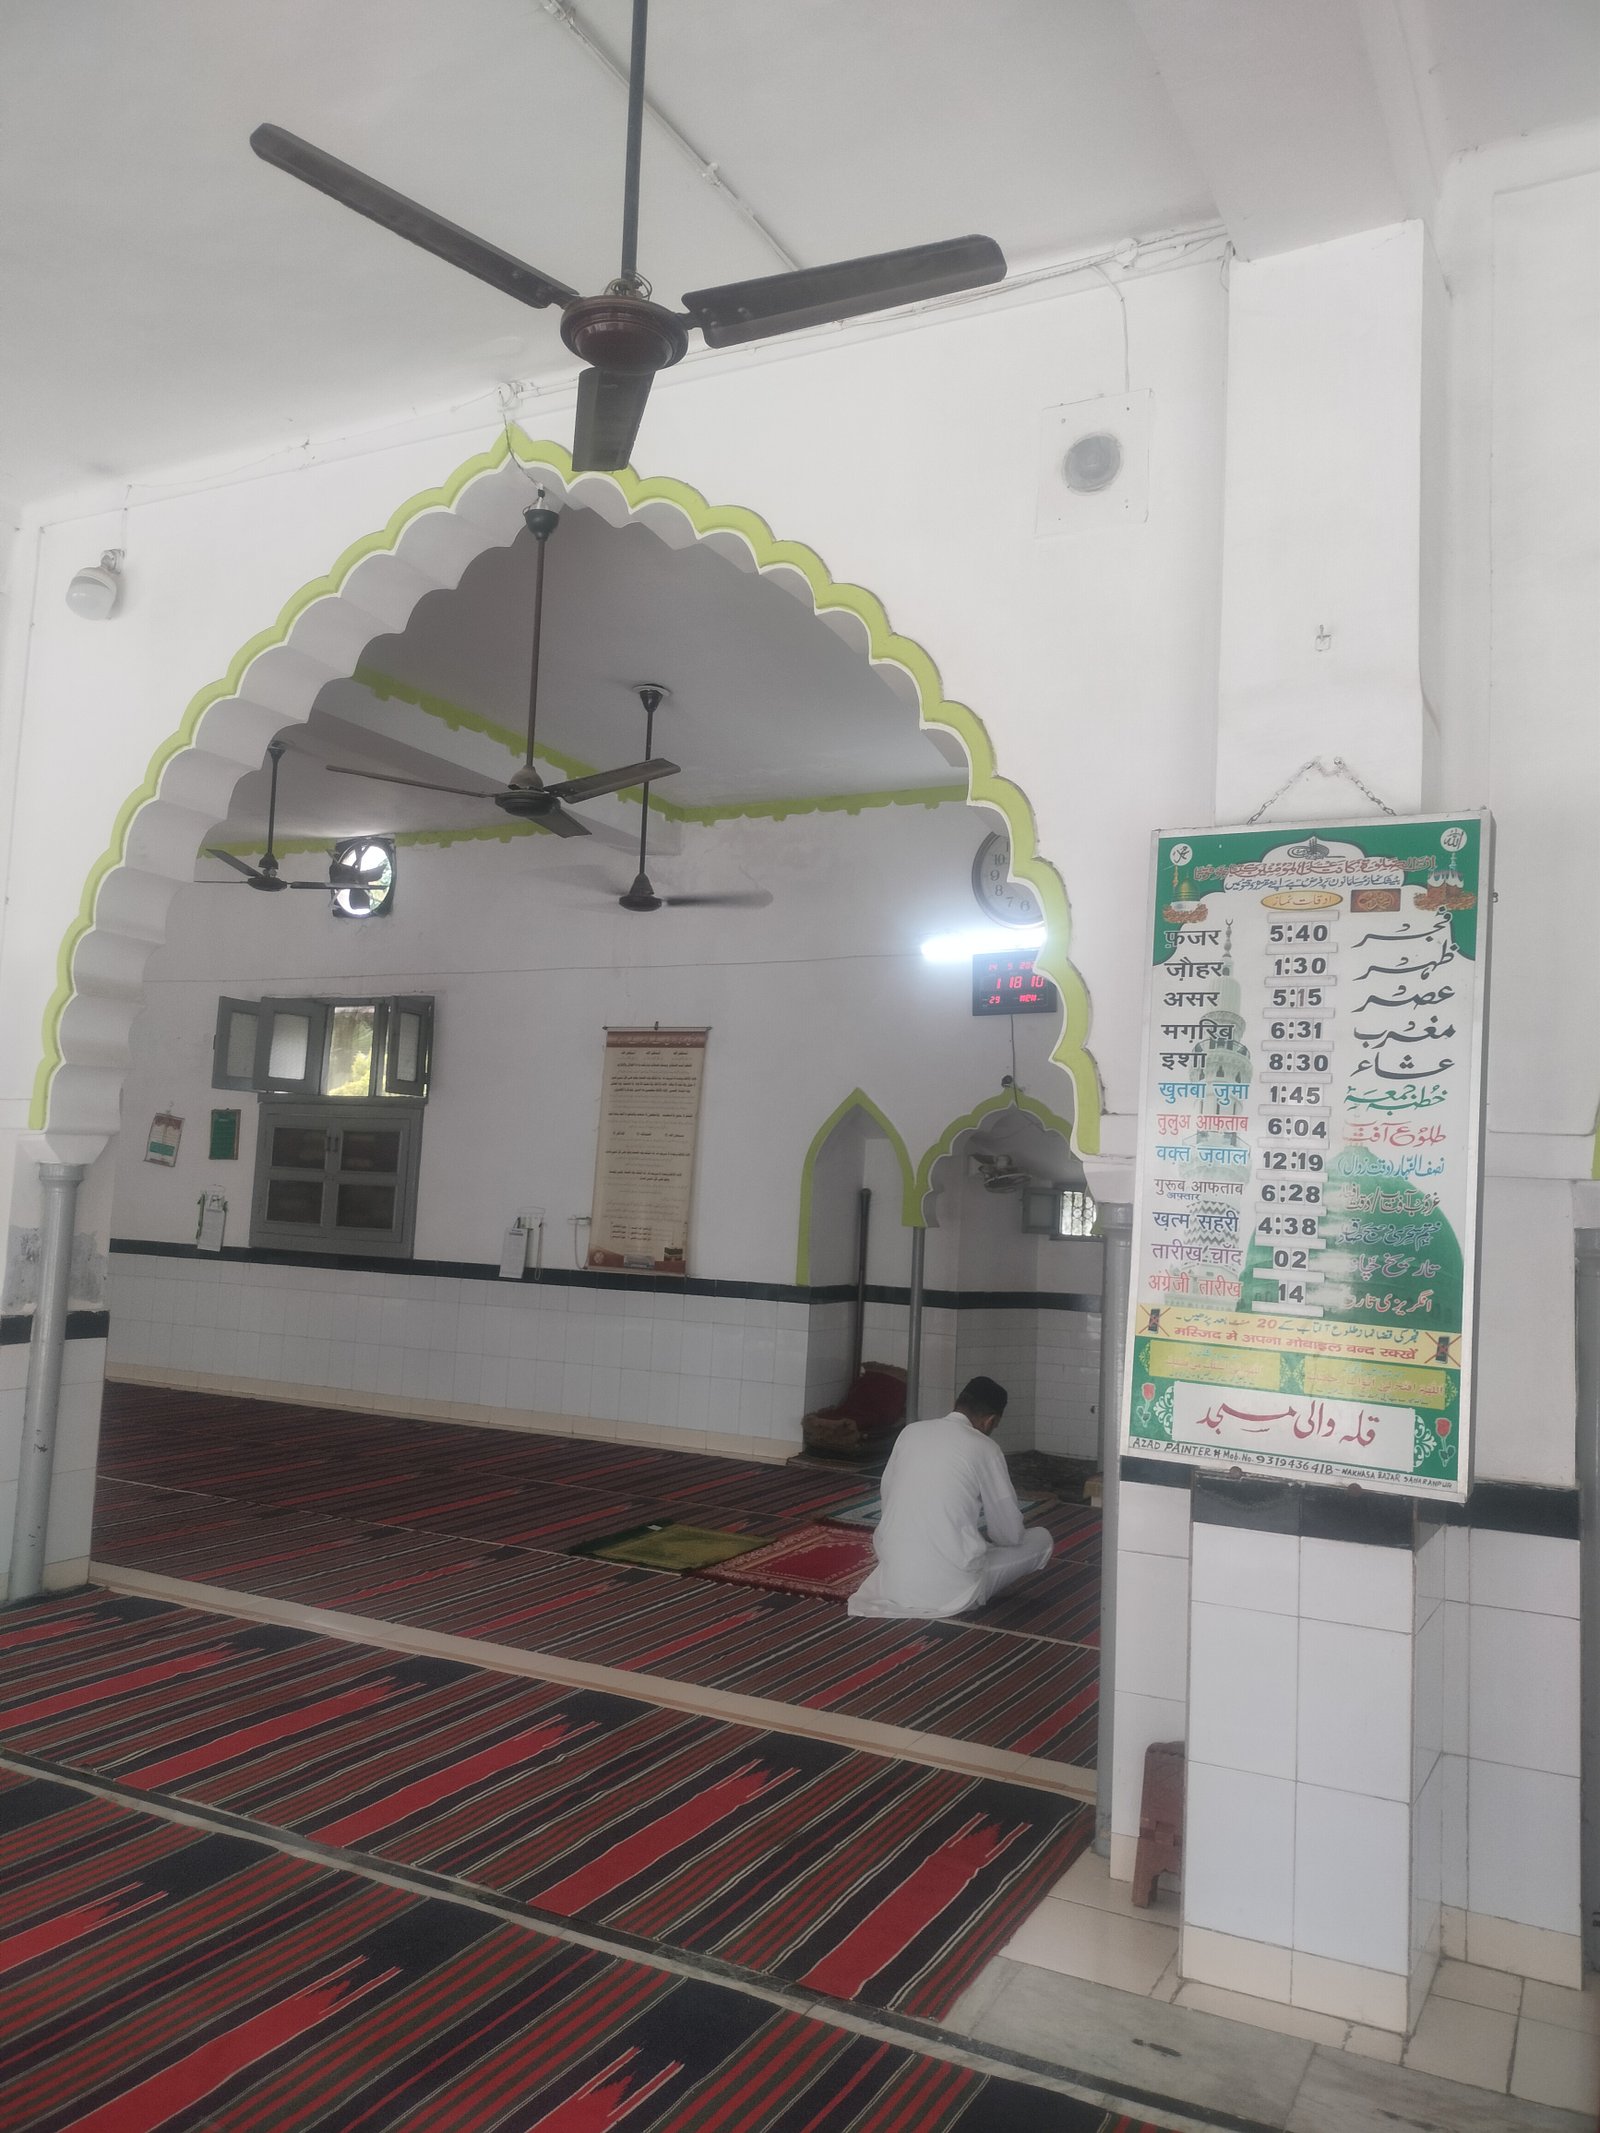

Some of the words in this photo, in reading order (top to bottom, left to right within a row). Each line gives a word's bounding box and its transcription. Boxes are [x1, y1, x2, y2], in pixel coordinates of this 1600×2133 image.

[990, 869, 1000, 881] 9
[995, 885, 1003, 896] 8
[1270, 925, 1328, 942] 5:40
[1351, 906, 1452, 949] فجر
[1275, 958, 1326, 975] 1:30
[1009, 975, 1023, 989] 18
[1031, 975, 1044, 988] 10
[1163, 992, 1220, 1008] असर
[1273, 988, 1322, 1007] 5:15
[1351, 984, 1455, 1013] عصر
[1271, 1021, 1322, 1039] 6:31
[1353, 1014, 1456, 1049] مغرب
[1160, 1052, 1207, 1070] इशा
[1269, 1053, 1328, 1071] 8:30
[1350, 1051, 1455, 1080] عشاء
[1158, 1082, 1206, 1104] खुतबा
[1212, 1083, 1249, 1105] जुमा
[1270, 1086, 1320, 1104] 1:45
[1268, 1118, 1326, 1138] 6:04
[1263, 1151, 1323, 1171] 12:19
[1261, 1184, 1320, 1203] 6:28
[1196, 1209, 1240, 1233] सहरी
[1258, 1217, 1316, 1235] 4:38
[1274, 1250, 1307, 1269] 02
[1279, 1283, 1304, 1303] 14
[1257, 1318, 1278, 1329] 20
[1174, 1325, 1221, 1339] मस्जिद
[1242, 1333, 1281, 1346] अपना
[1196, 1403, 1298, 1435] مسجد
[1293, 1400, 1336, 1439] والی
[1132, 1438, 1161, 1450] AZAD
[1164, 1441, 1211, 1457] PAINTER
[1255, 1455, 1334, 1475] 9319436418
